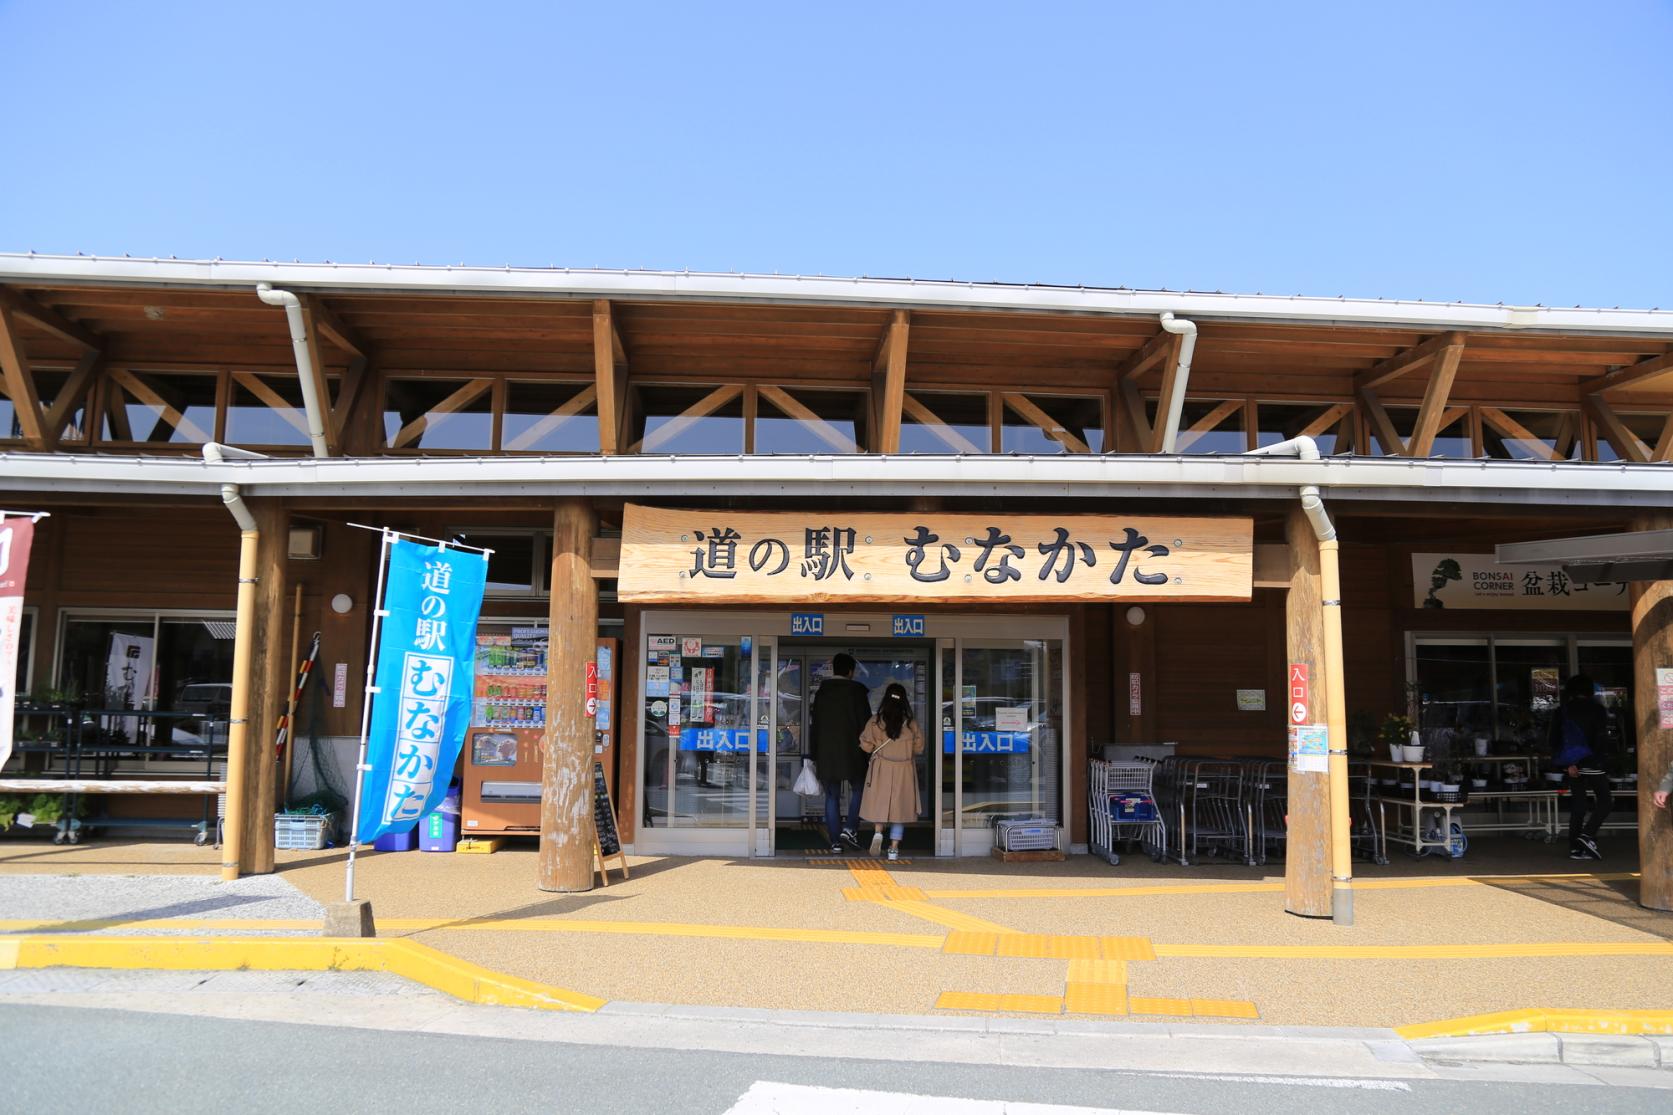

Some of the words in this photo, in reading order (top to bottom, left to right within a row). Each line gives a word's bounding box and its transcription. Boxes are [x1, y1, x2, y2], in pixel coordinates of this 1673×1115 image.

[688, 527, 855, 580] 道の駅
[903, 526, 1170, 585] むなかた
[1472, 571, 1513, 581] BONSAI
[1473, 581, 1514, 591] CORNER
[413, 561, 453, 651] 道の駅
[792, 616, 823, 633] 出入口
[894, 618, 924, 635] 出入口
[588, 665, 598, 693] 入口
[1292, 668, 1306, 698] 入口
[389, 659, 446, 820] むなかた
[697, 730, 751, 750] 出入口
[962, 733, 1014, 752] 出入口
